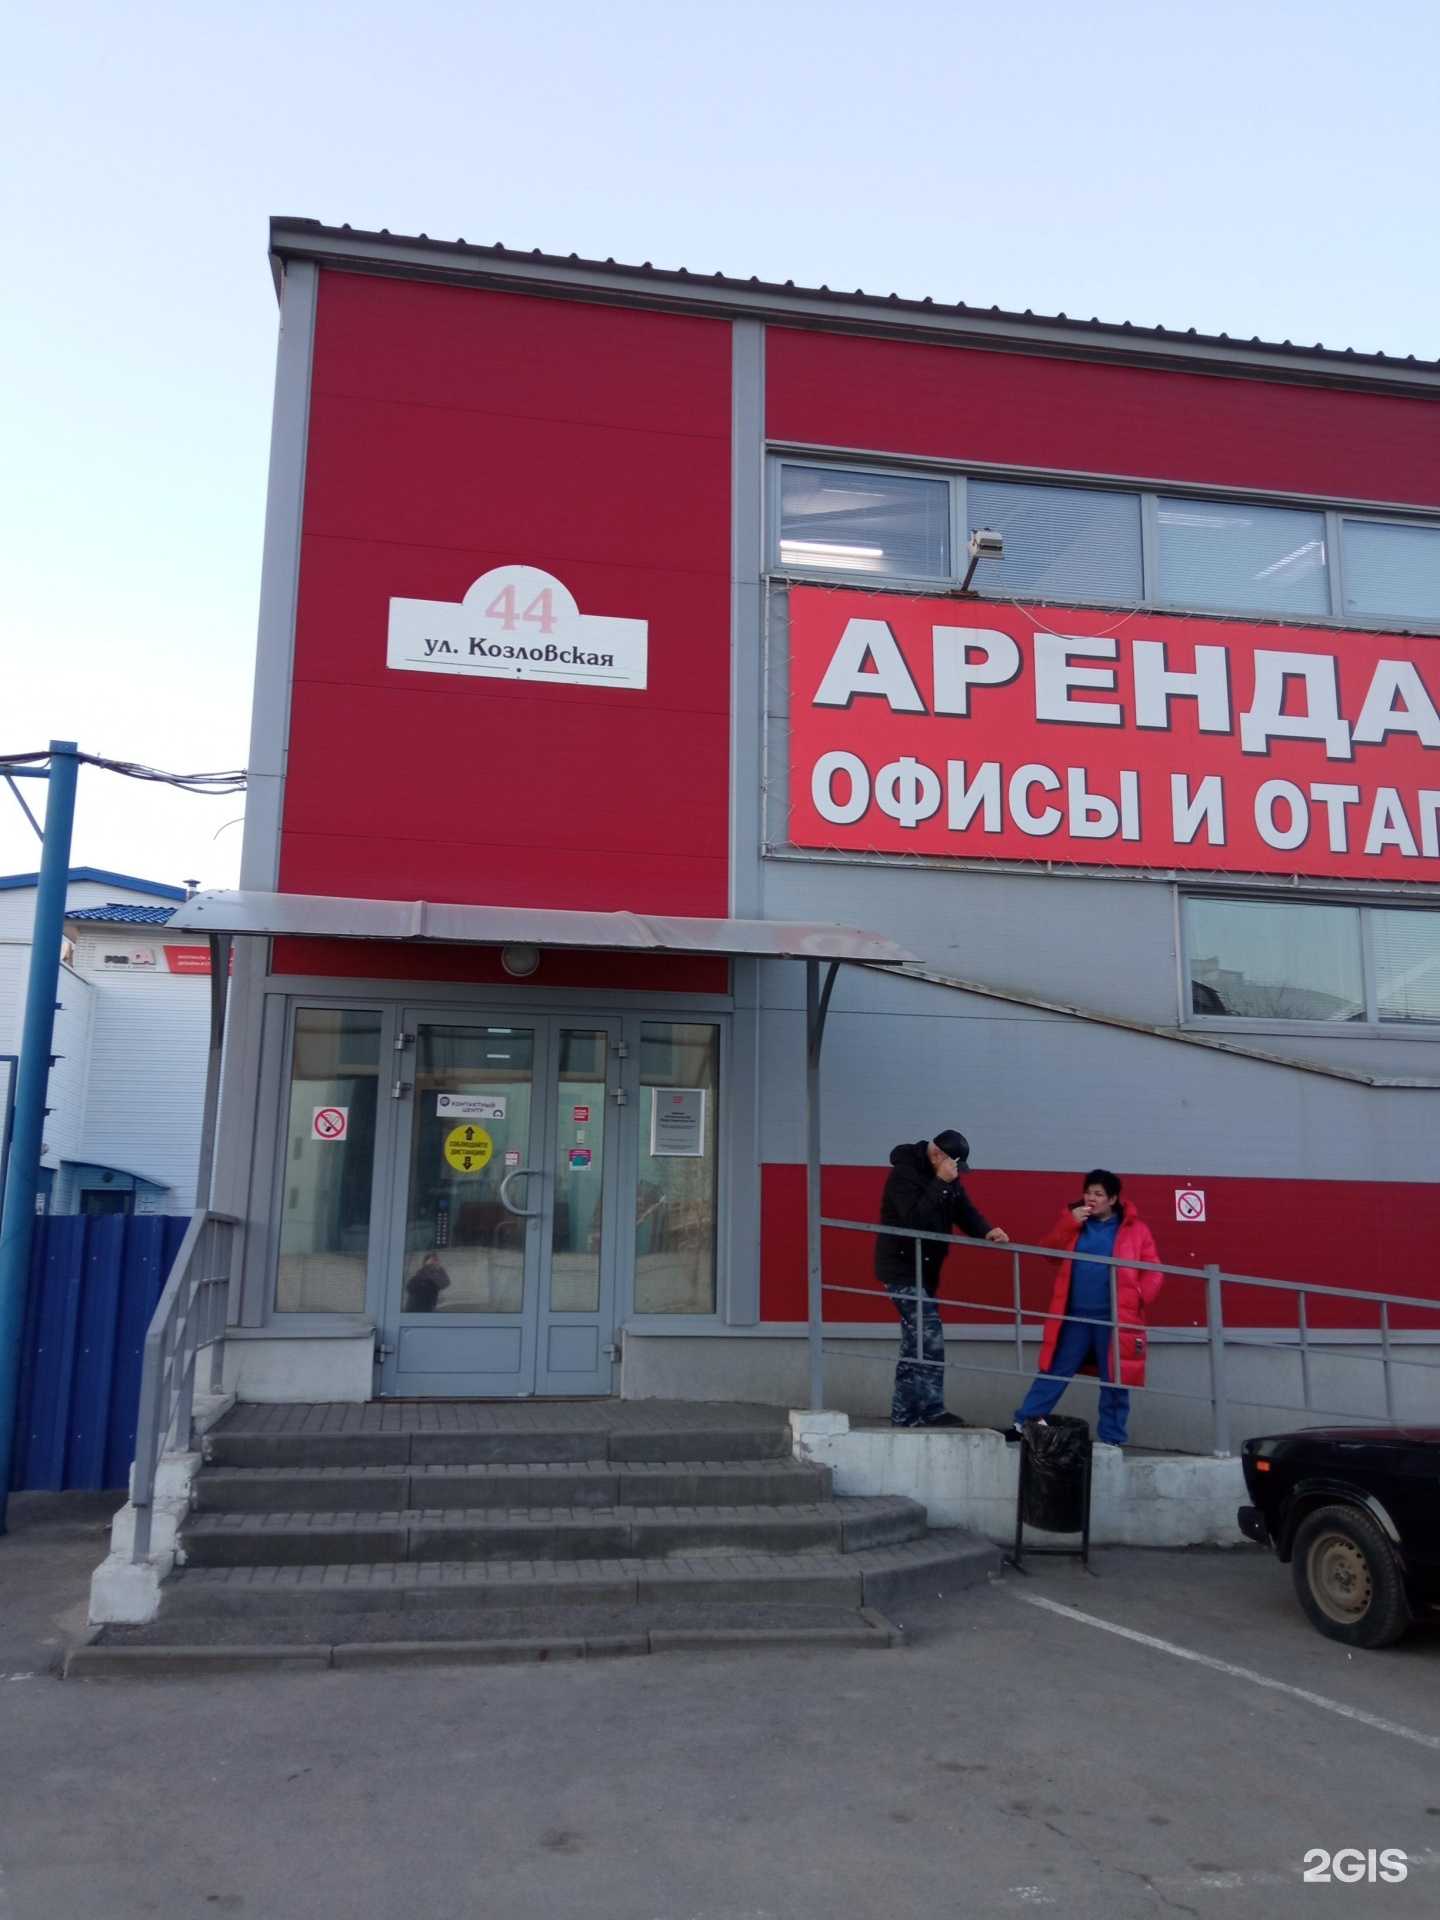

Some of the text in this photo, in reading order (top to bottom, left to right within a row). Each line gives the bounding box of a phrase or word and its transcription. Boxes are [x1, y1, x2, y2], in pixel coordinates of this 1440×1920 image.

[485, 584, 558, 634] 44
[424, 636, 614, 667] ул. Козловская
[812, 617, 1440, 760] АРЕНДА
[811, 751, 1142, 841] ОФИСЫ
[1170, 773, 1225, 846] И
